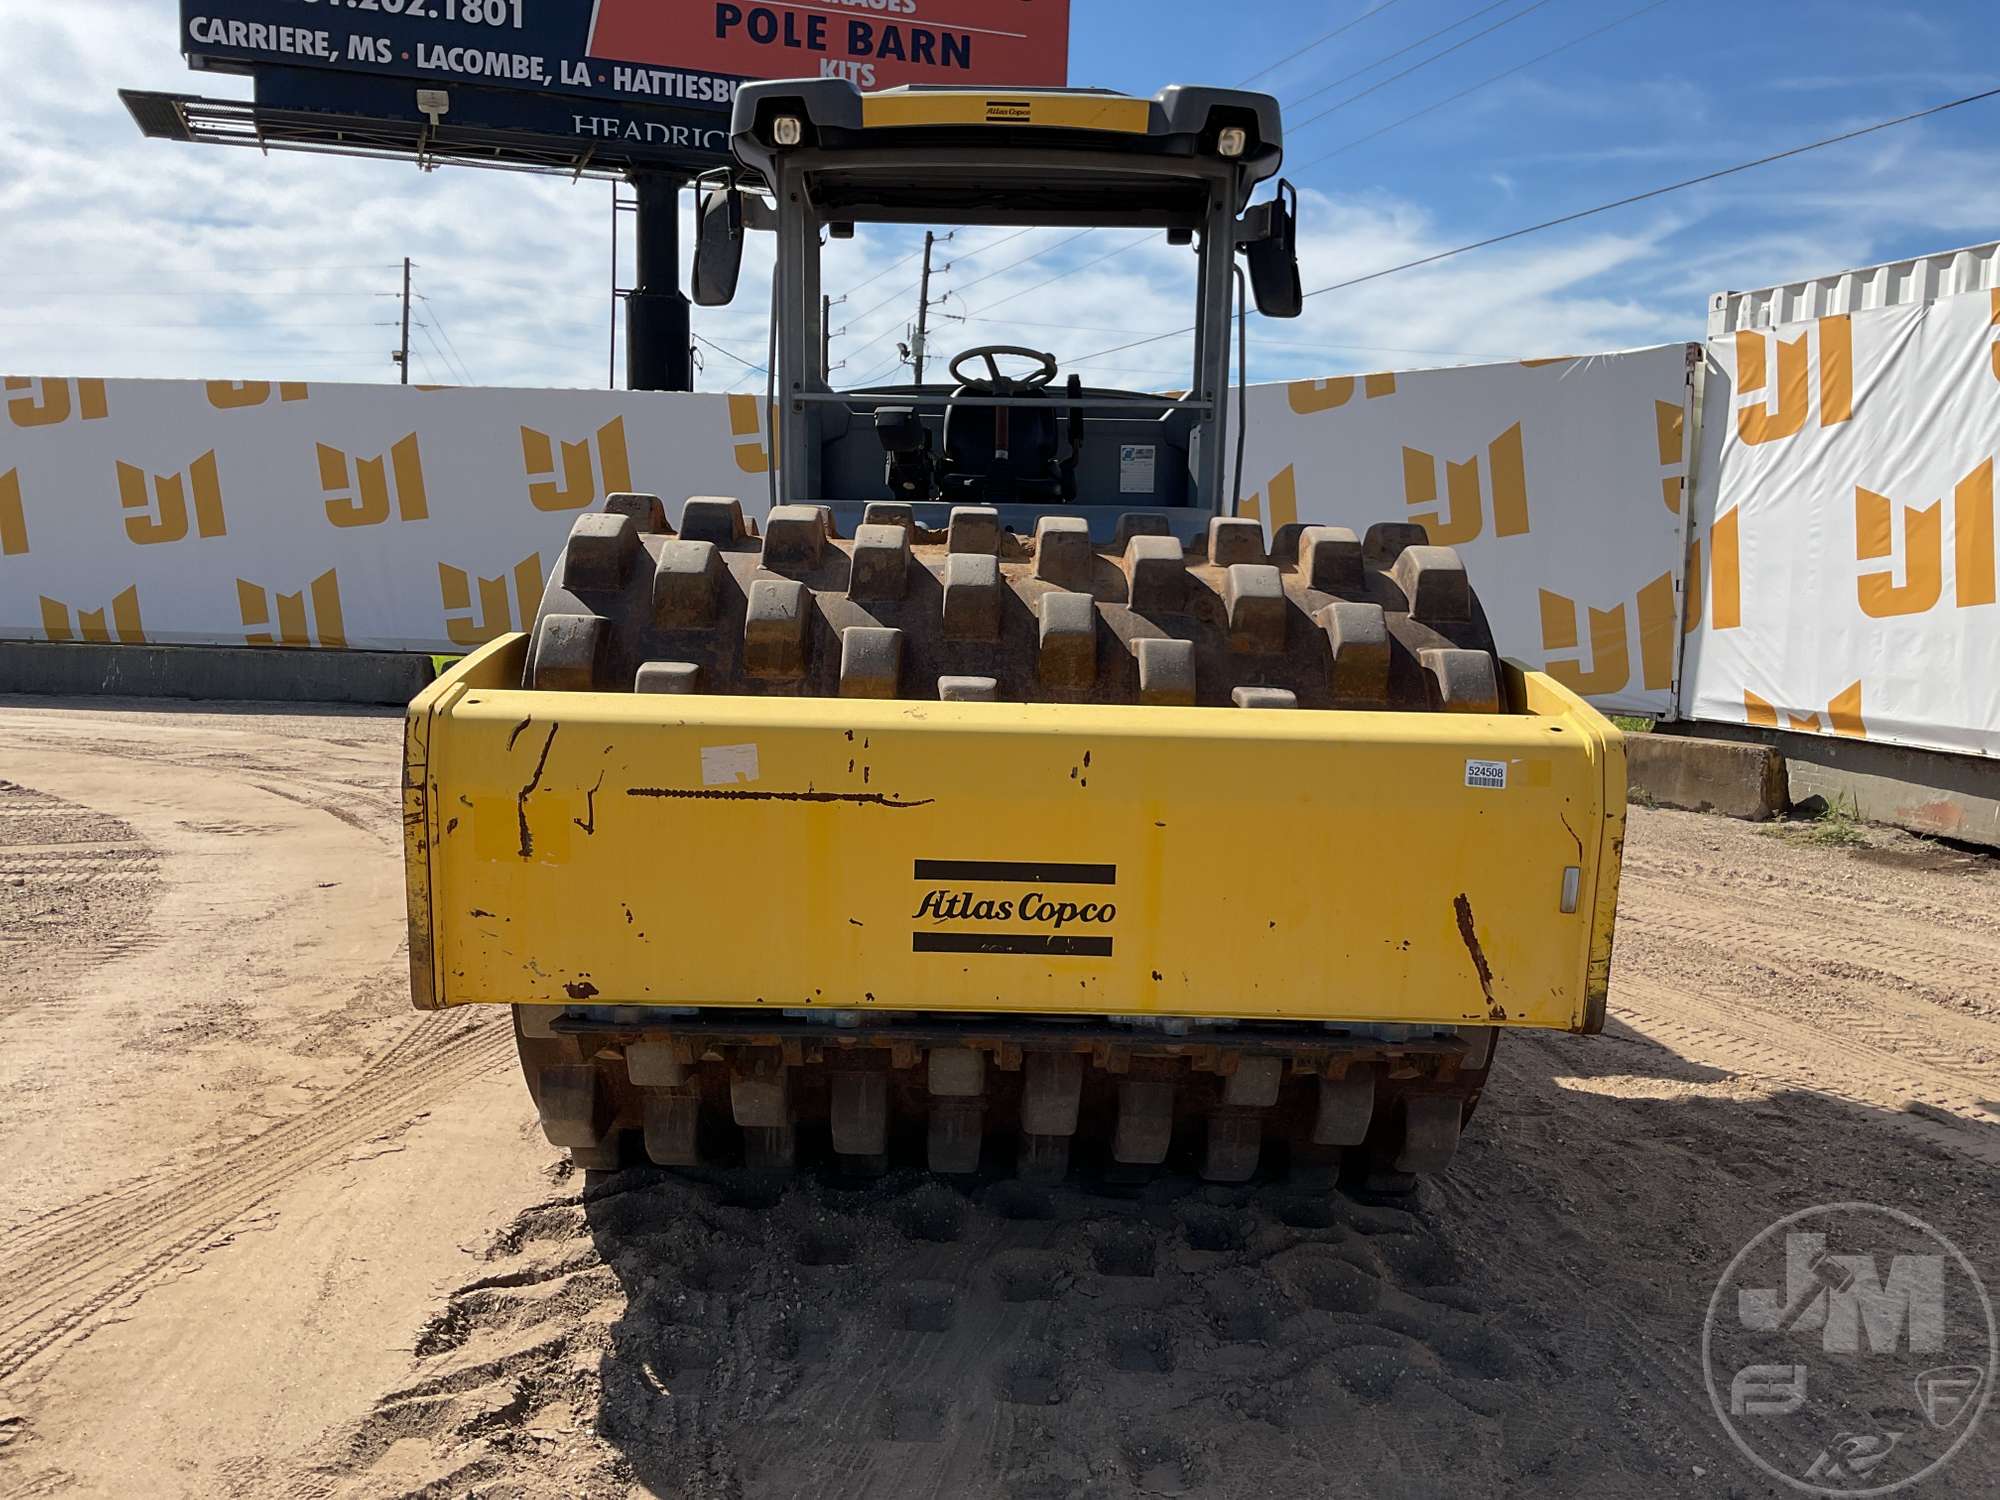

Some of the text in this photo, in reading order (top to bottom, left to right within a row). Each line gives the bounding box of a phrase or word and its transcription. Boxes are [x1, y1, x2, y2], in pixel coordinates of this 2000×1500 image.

[189, 16, 340, 62] CARRIERE,
[349, 34, 393, 63] MS
[416, 42, 552, 86] LACOMBE,
[560, 59, 593, 87] LA
[715, 3, 970, 69] POLE BARN
[819, 57, 876, 87] KITS
[1468, 765, 1504, 778] 524508
[912, 889, 1117, 929] Atlas Copco
